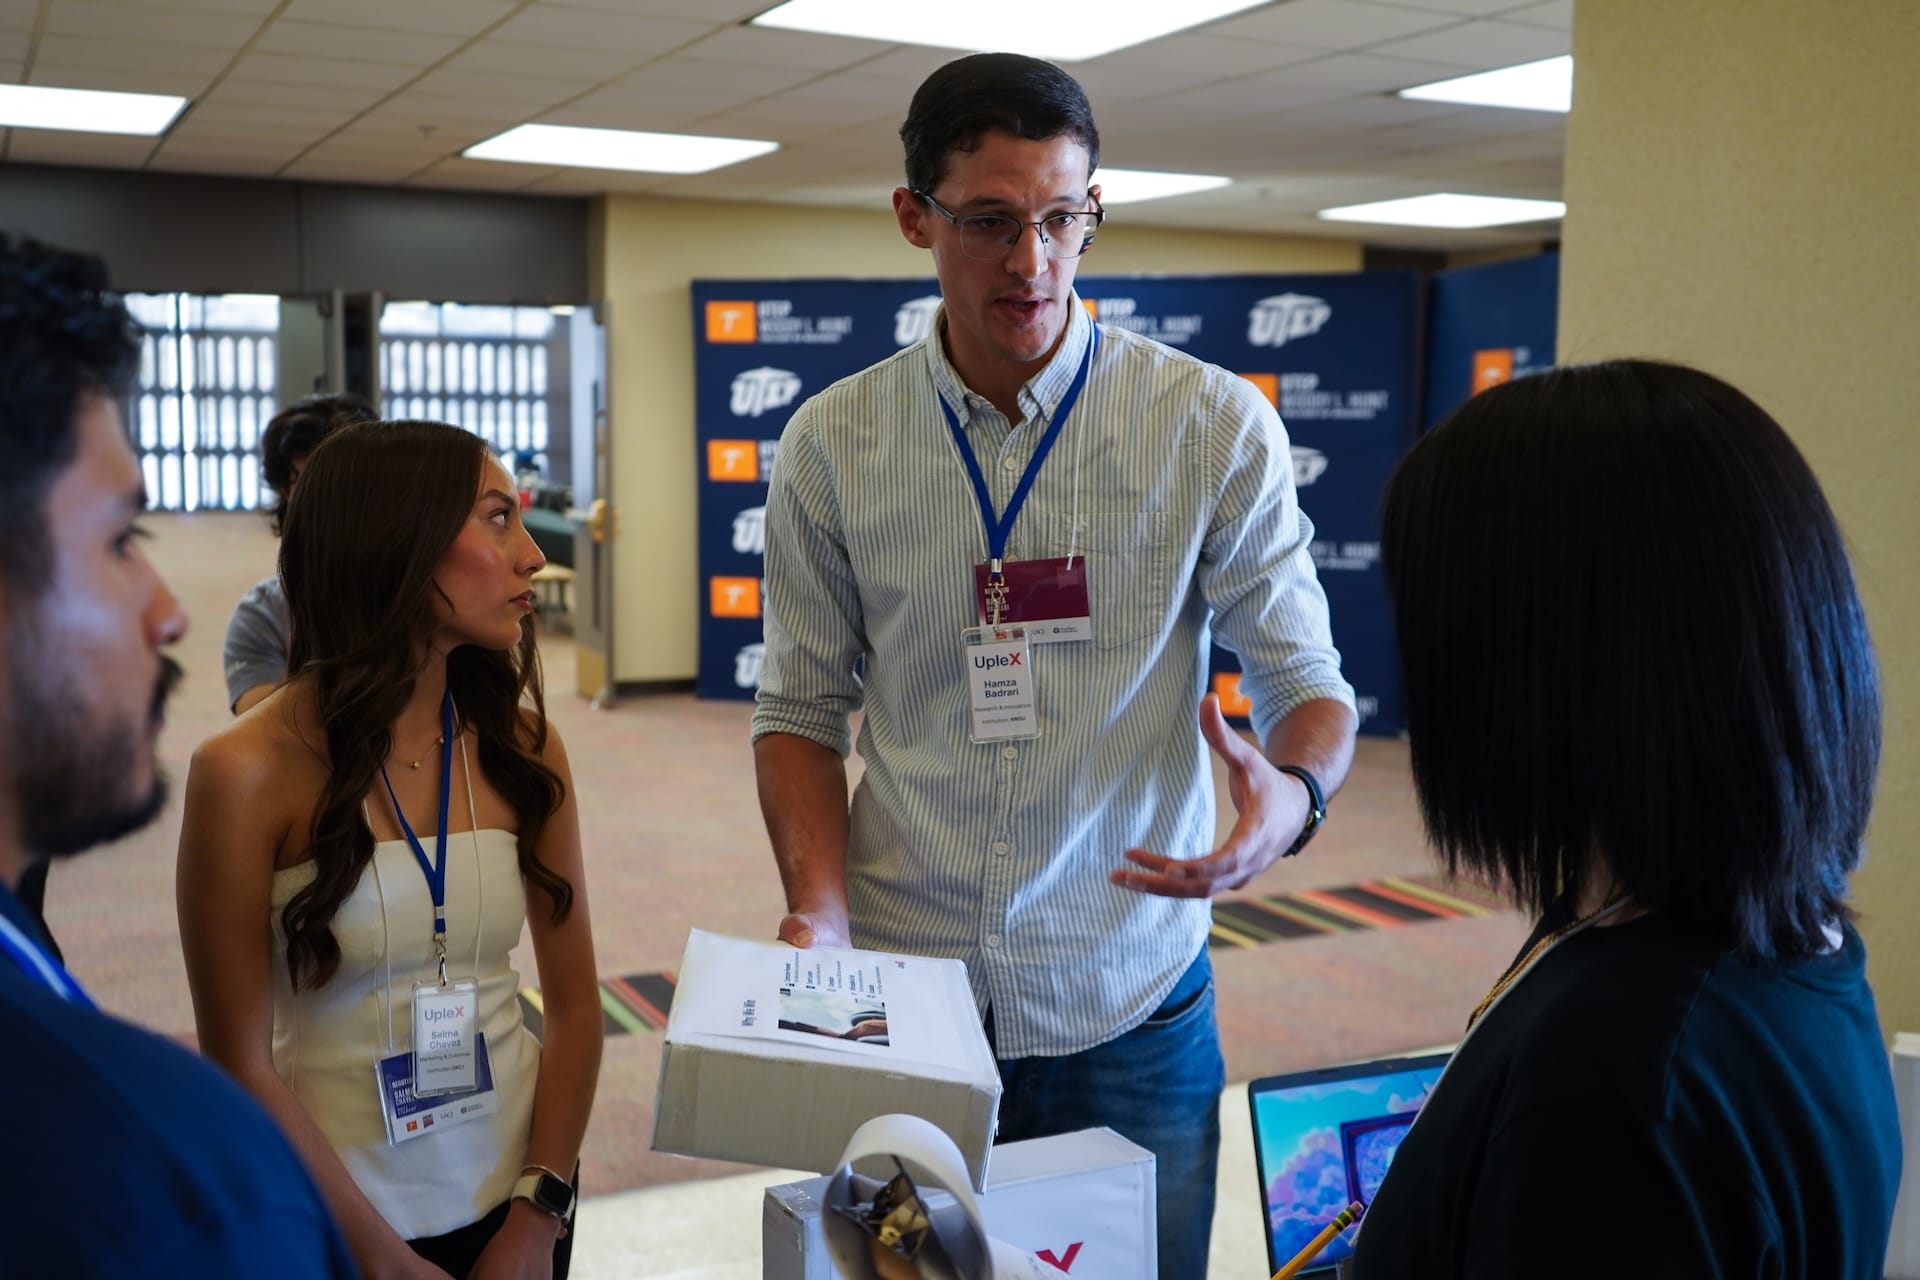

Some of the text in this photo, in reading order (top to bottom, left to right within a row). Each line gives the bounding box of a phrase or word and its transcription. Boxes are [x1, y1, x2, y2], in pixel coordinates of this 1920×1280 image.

[975, 652, 1022, 670] UpleX
[984, 680, 1017, 689] Hamza
[985, 688, 1019, 698] Badrari
[424, 1006, 464, 1023] UpleX
[431, 1030, 459, 1040] Salma
[430, 1039, 461, 1049] Chavez
